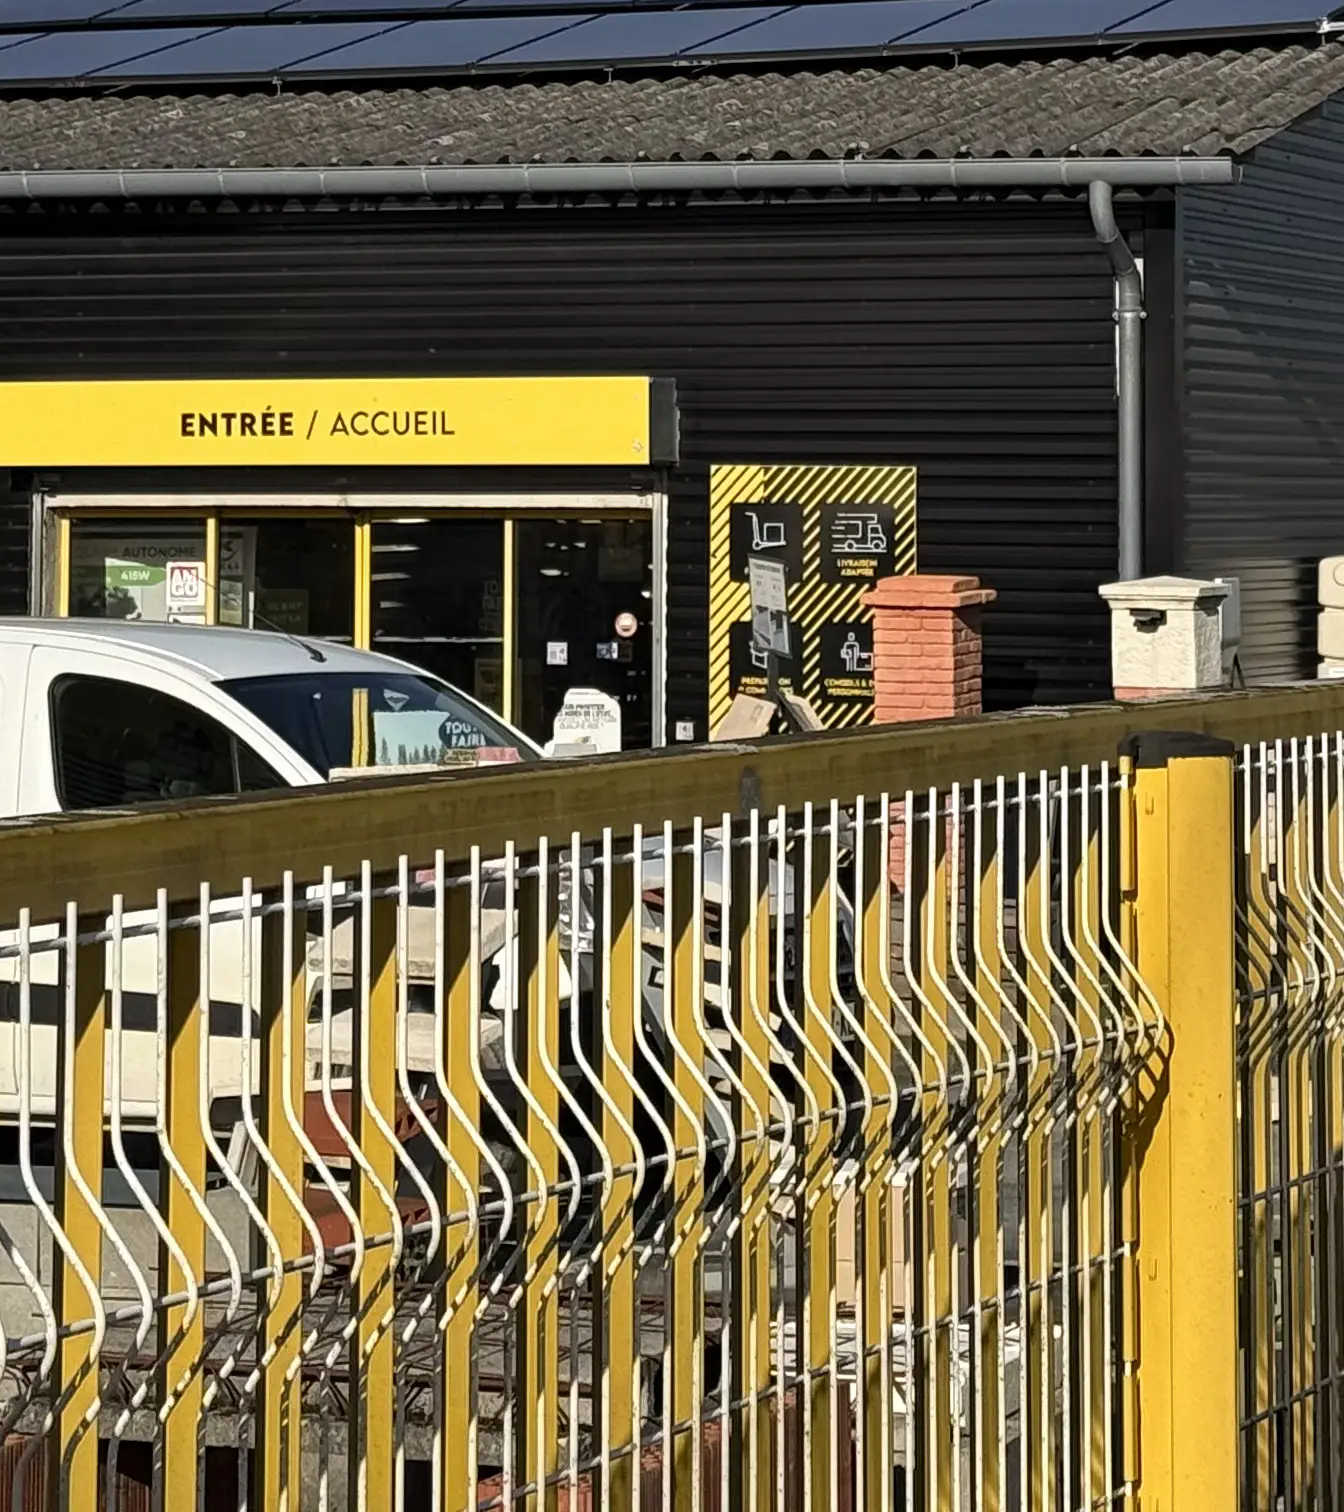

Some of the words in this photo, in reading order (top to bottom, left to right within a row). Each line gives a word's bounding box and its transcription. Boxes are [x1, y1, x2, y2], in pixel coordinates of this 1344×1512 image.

[181, 405, 295, 437] ENTRÉE
[307, 409, 319, 440] /
[330, 410, 456, 437] ACCUEIL
[122, 545, 197, 559] AUTONOME
[445, 721, 478, 735] TOU
